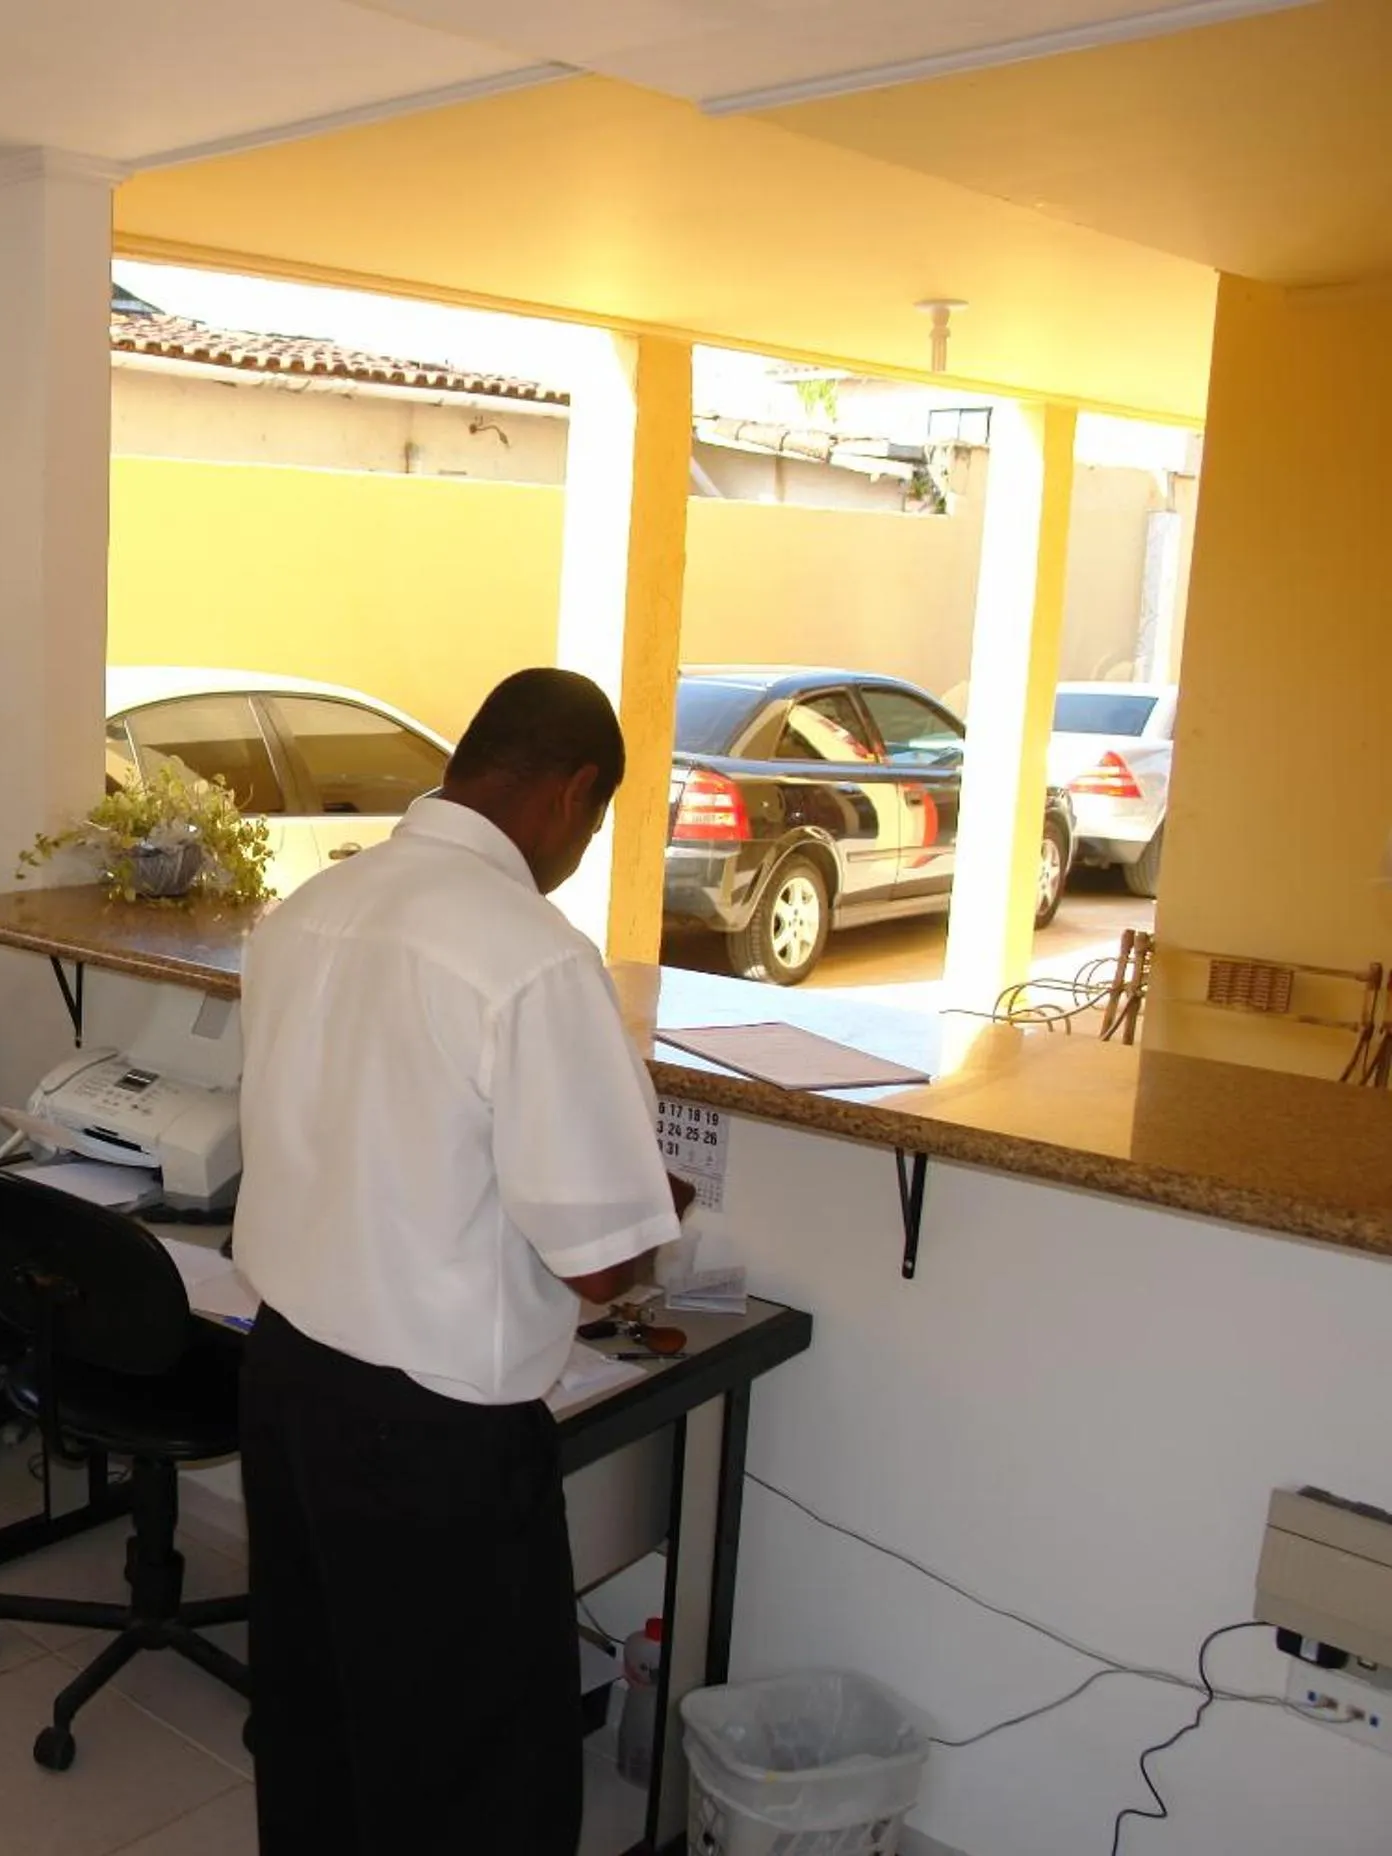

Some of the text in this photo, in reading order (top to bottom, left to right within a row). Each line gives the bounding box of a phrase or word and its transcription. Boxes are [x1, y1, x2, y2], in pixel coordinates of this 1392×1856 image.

[658, 1102, 719, 1126] 6 17 18 19
[656, 1120, 717, 1146] 3 24 25 26
[666, 1141, 679, 1156] 31
